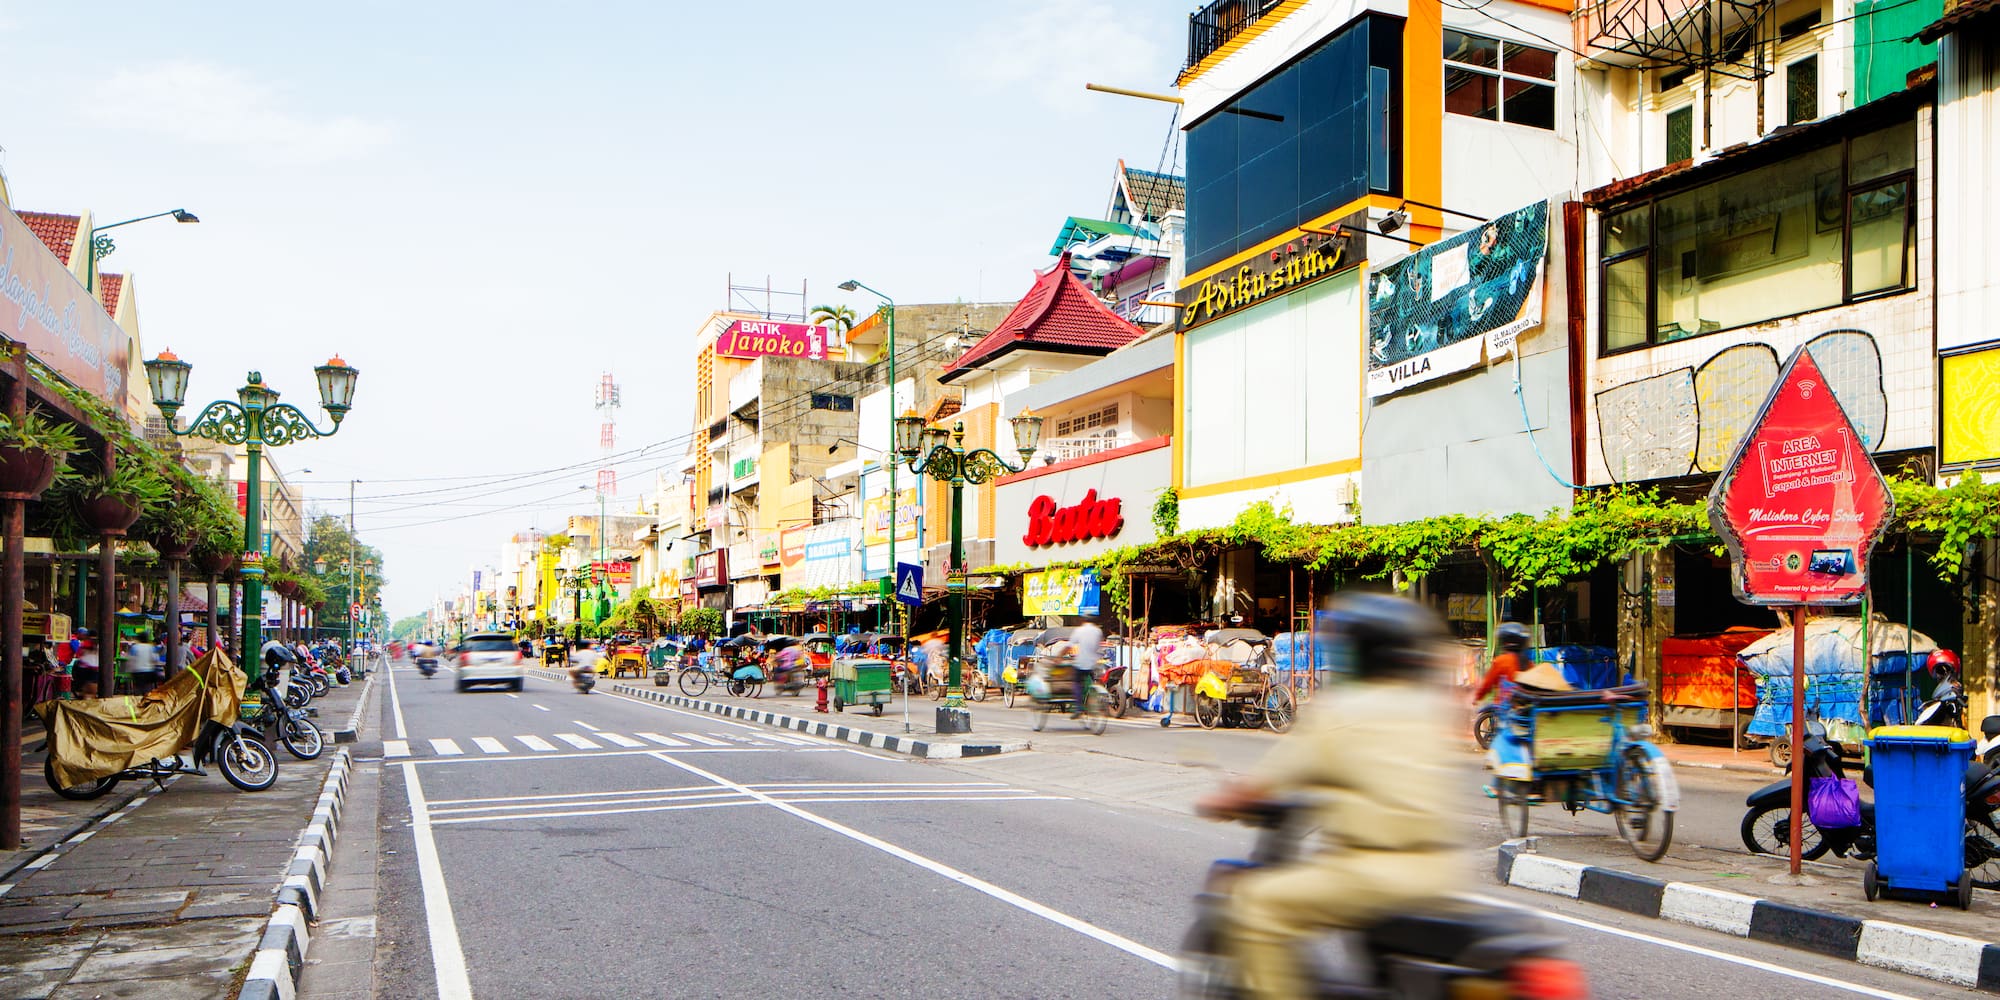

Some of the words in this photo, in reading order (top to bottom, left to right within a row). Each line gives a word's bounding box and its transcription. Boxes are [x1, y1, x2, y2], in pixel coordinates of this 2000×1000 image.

[741, 321, 781, 336] BATIK
[723, 330, 805, 356] Janoko
[1389, 357, 1431, 384] VILLA
[1783, 436, 1821, 455] AREA
[1770, 449, 1838, 473] INTERNET
[1772, 480, 1801, 492] cepat
[1801, 477, 1811, 487] &
[1811, 471, 1844, 486] handal
[1022, 488, 1123, 548] Bata
[1748, 508, 1799, 522] Malioboro
[1801, 508, 1830, 525] Cyber
[1833, 508, 1865, 523] Street
[1801, 585, 1810, 594] by
